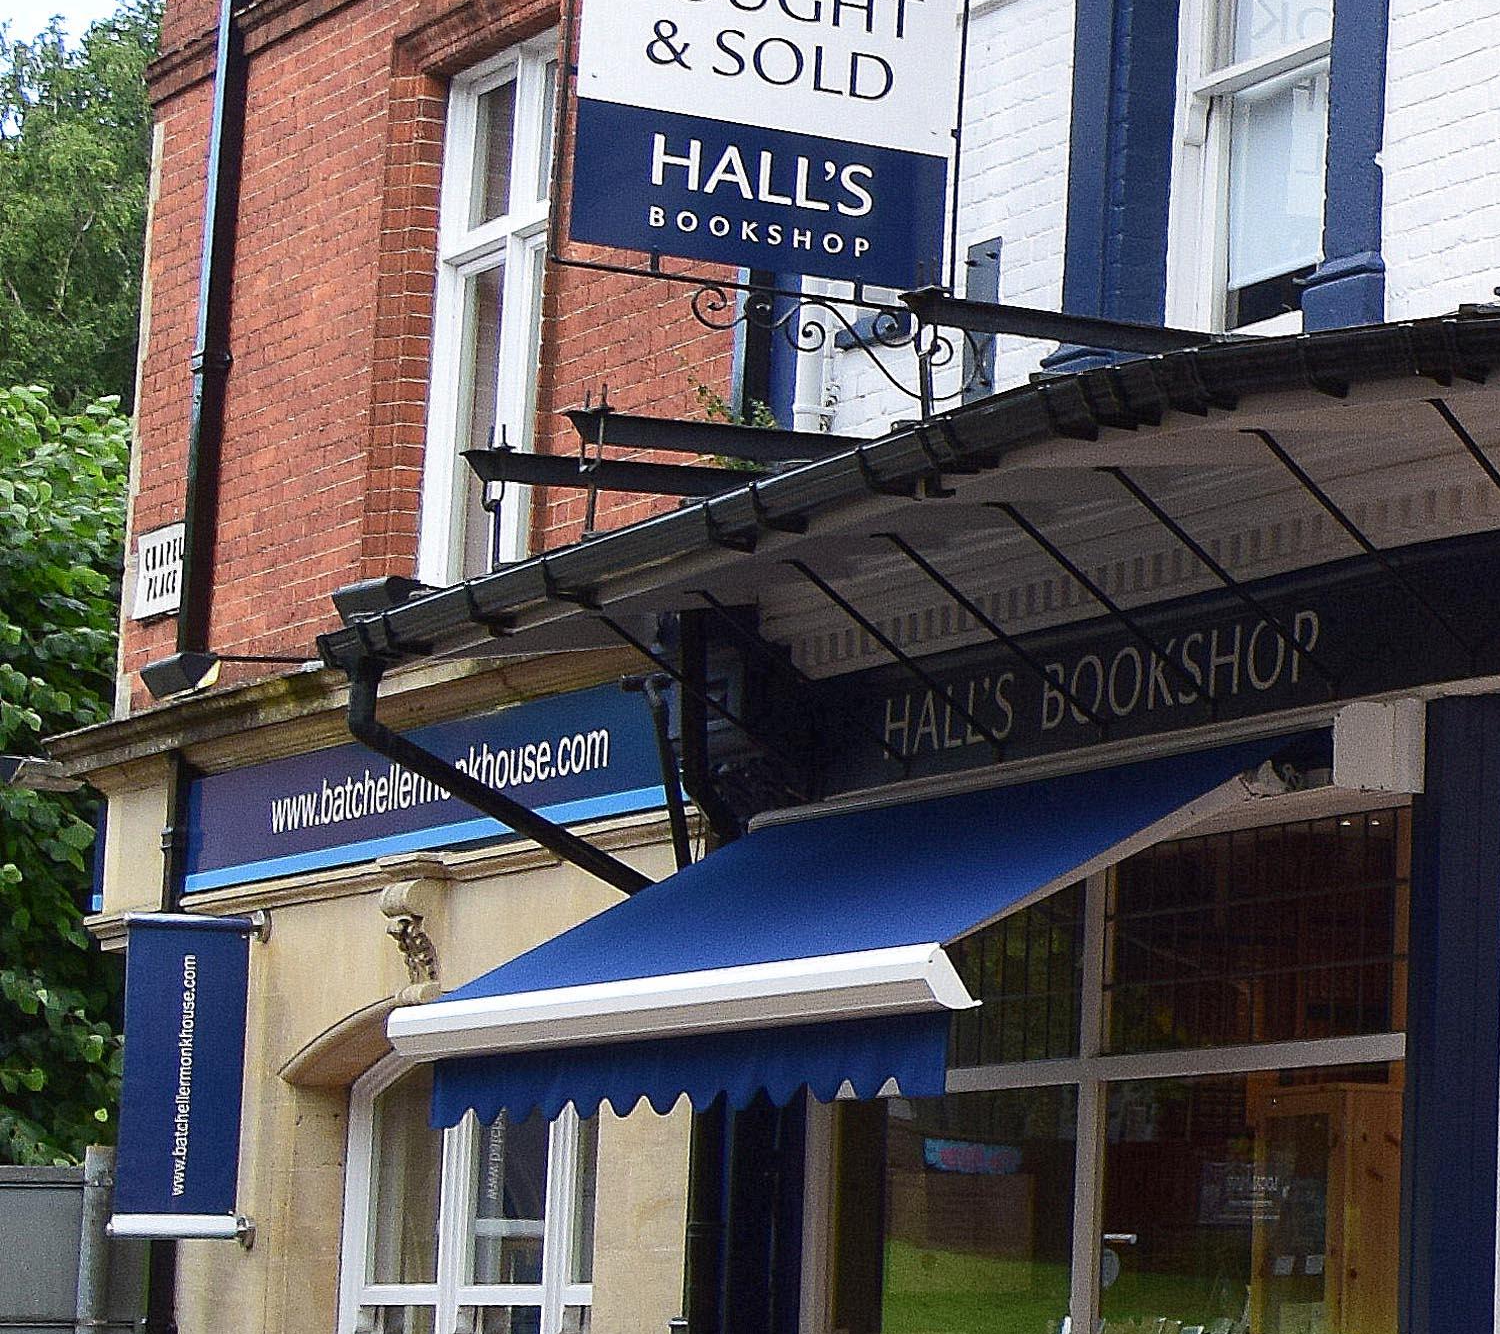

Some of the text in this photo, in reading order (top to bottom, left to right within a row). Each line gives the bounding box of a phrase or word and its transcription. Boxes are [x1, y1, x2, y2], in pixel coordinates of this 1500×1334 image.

[645, 21, 894, 102] & SOLD
[650, 132, 874, 217] HALL’S
[648, 206, 871, 258] BOOKSHOP
[145, 537, 184, 571] CHAPEL
[146, 570, 177, 602] PLACE
[883, 610, 1319, 760] HALL’S BOOKSHOP
[171, 955, 196, 1197] www.batchellermonkhouse.com
